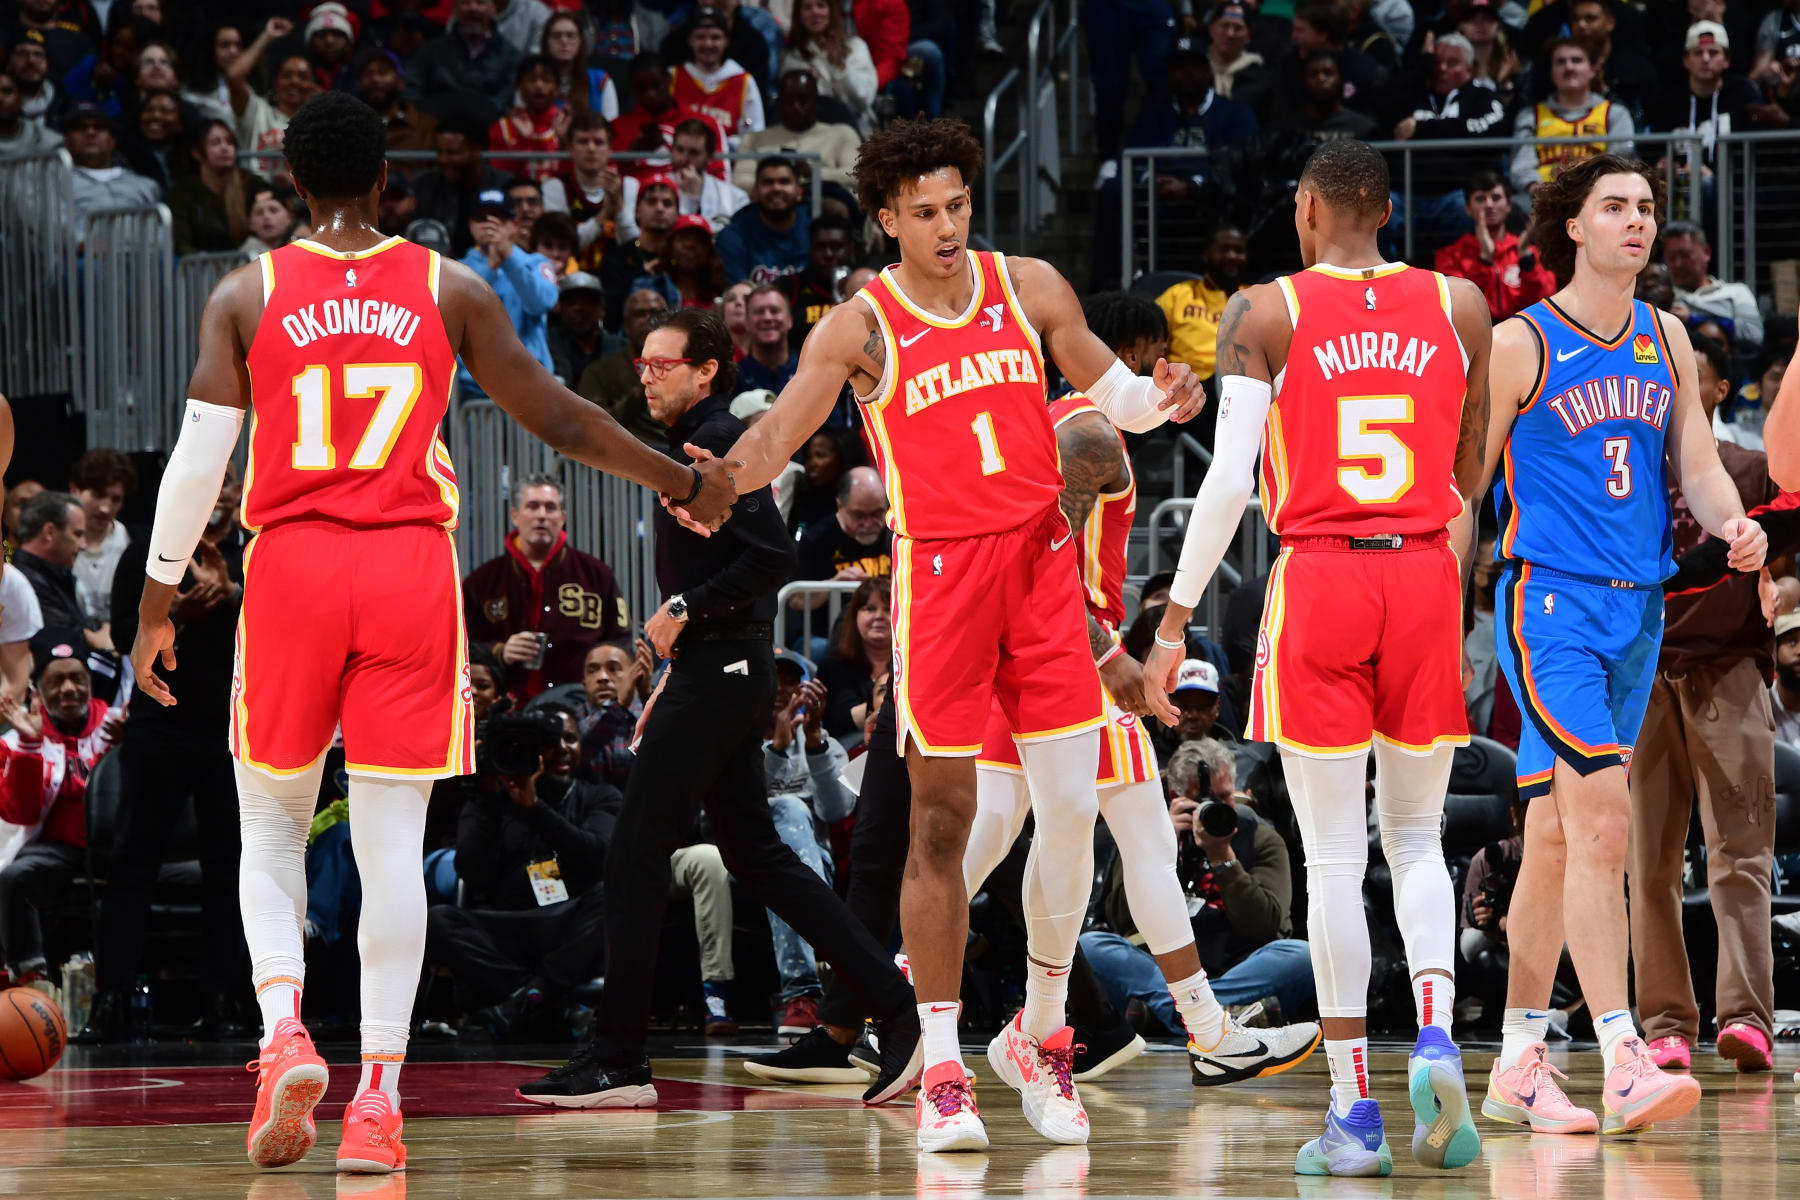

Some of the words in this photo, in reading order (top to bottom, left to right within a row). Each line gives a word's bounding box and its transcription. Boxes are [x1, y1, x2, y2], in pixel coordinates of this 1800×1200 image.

[281, 299, 421, 348] OKONGWU
[904, 348, 1040, 417] ATLANTA
[1312, 331, 1439, 380] MURRAY
[291, 363, 423, 470] 17
[1547, 375, 1672, 436] THUNDER
[970, 410, 1008, 477] 1
[1336, 393, 1416, 505] 5
[1604, 437, 1632, 498] 3
[558, 582, 603, 630] SB
